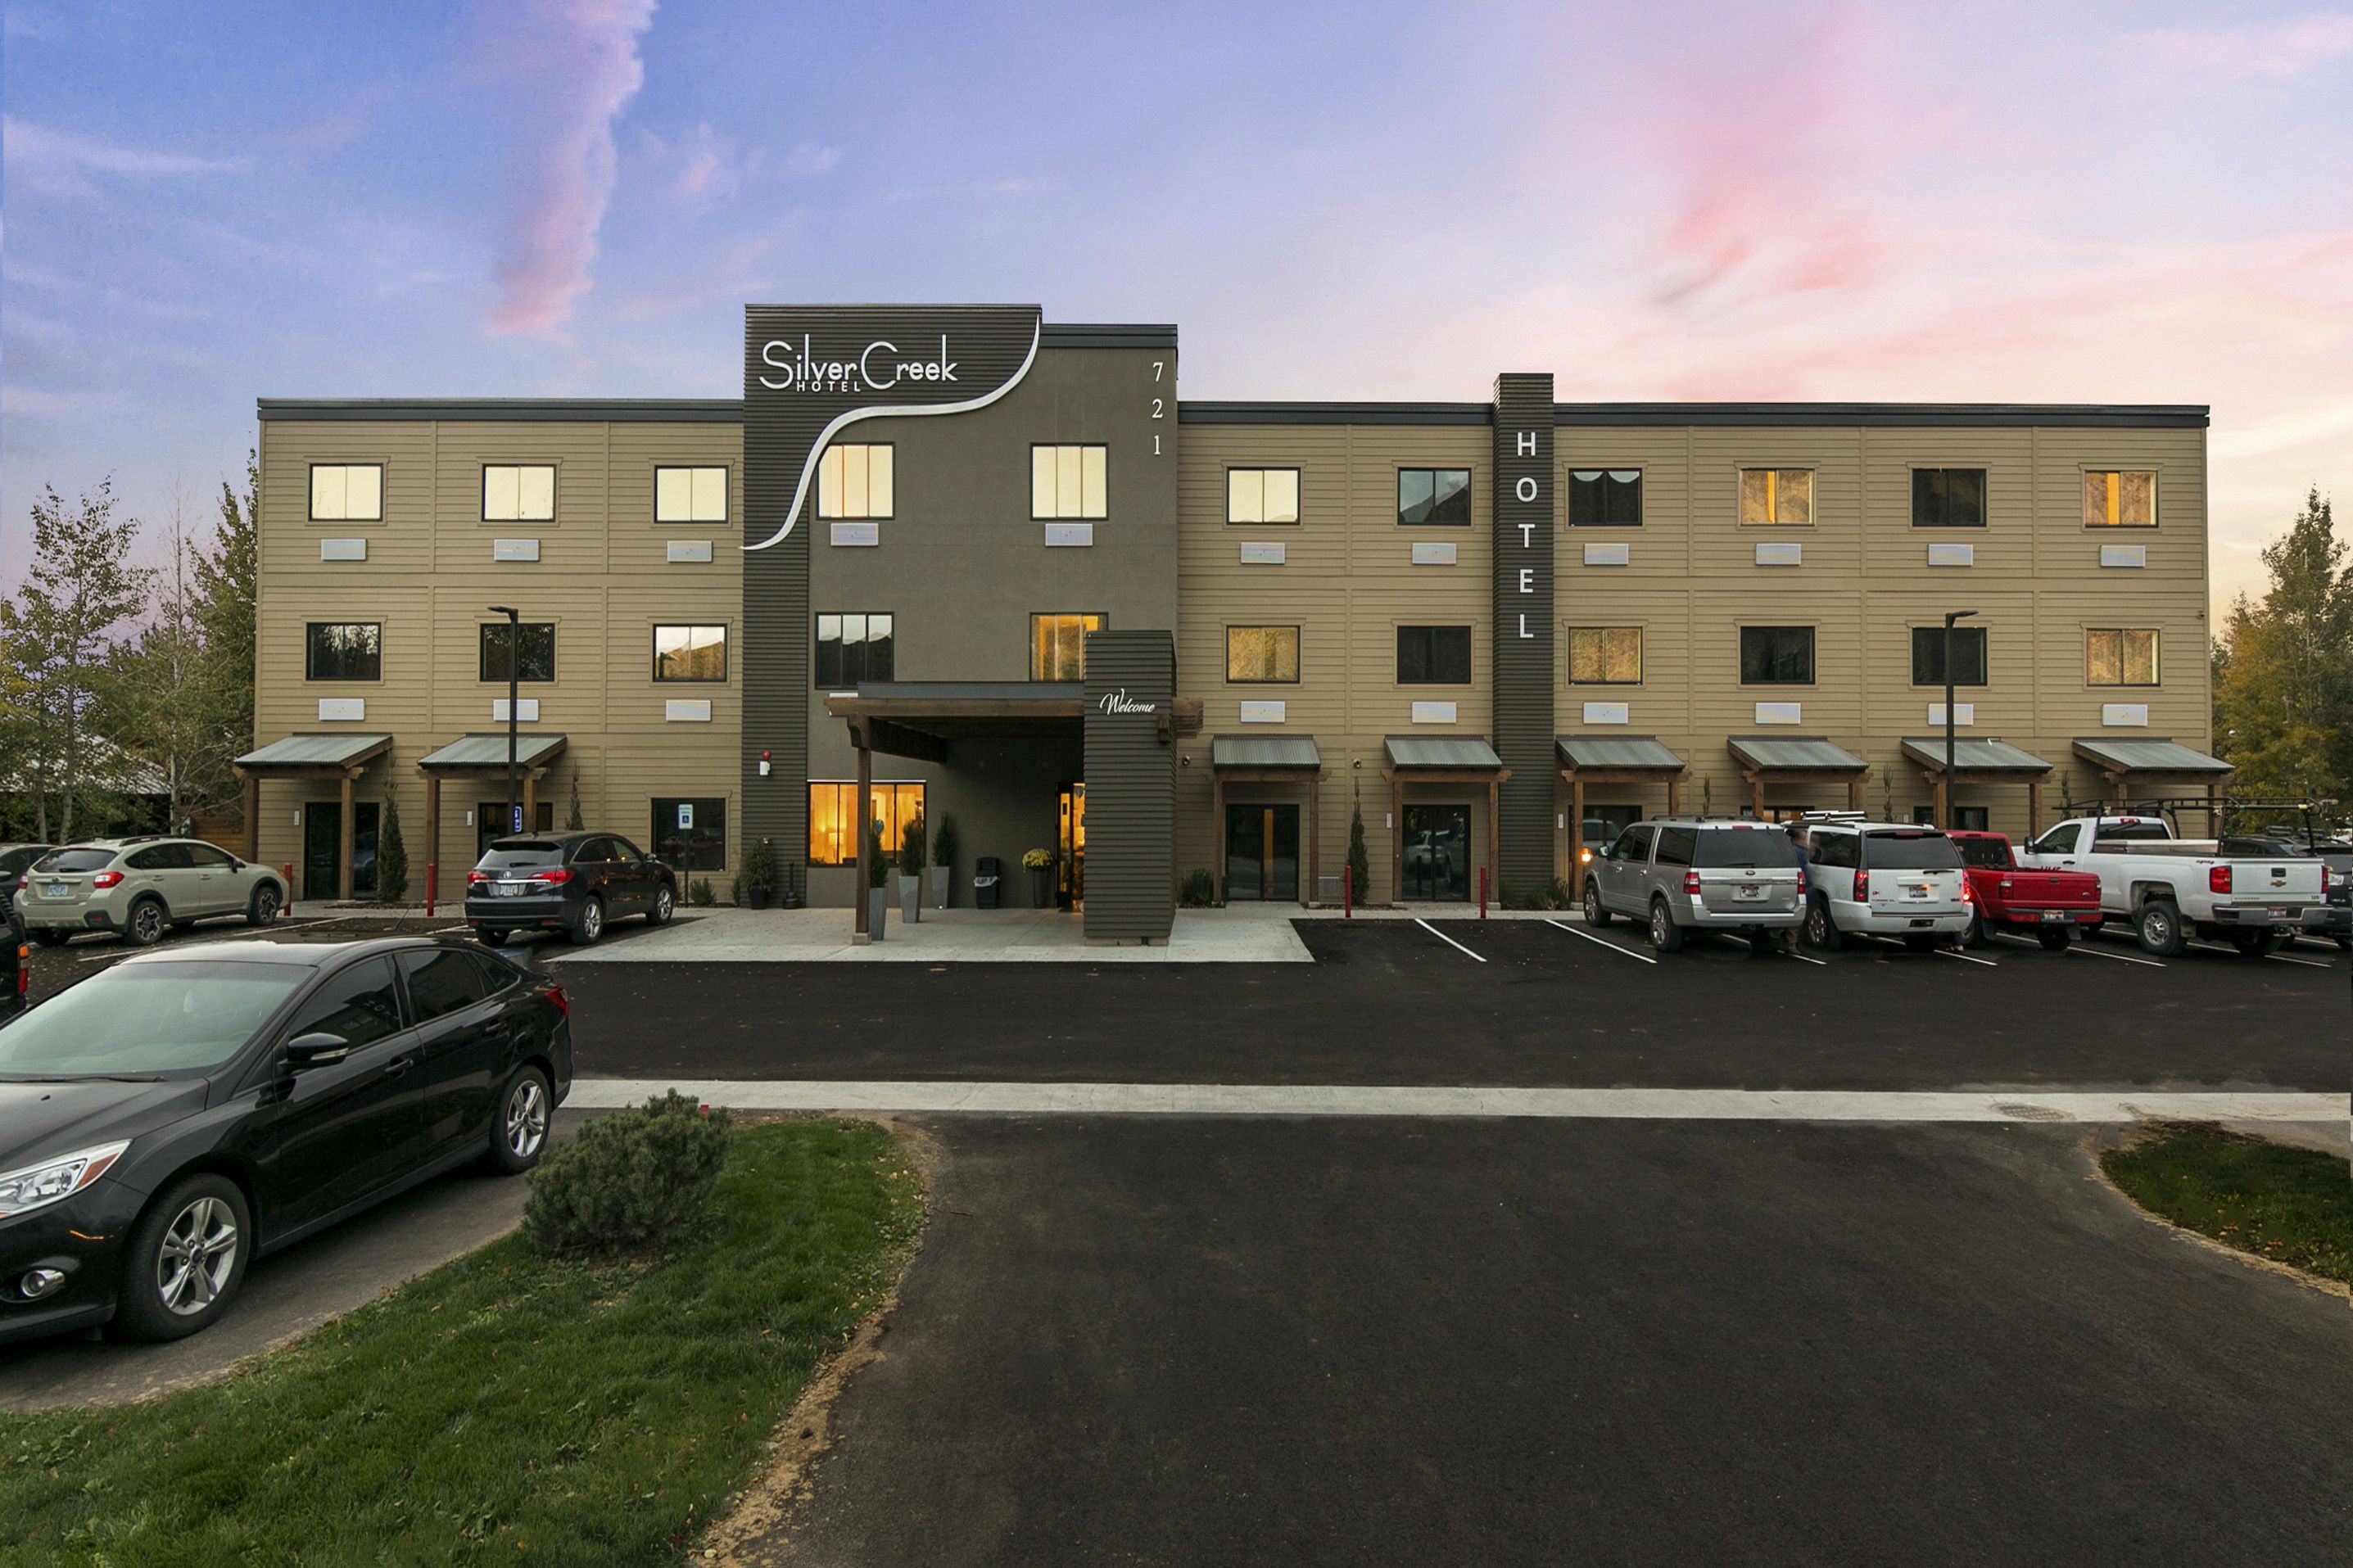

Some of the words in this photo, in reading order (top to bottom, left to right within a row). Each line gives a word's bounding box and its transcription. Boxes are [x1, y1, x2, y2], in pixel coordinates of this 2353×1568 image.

[759, 333, 857, 390] Silver
[861, 334, 958, 390] Creek
[796, 381, 861, 392] HOTEL
[1515, 432, 1538, 639] HOTEL
[1099, 688, 1156, 716] Welcome
